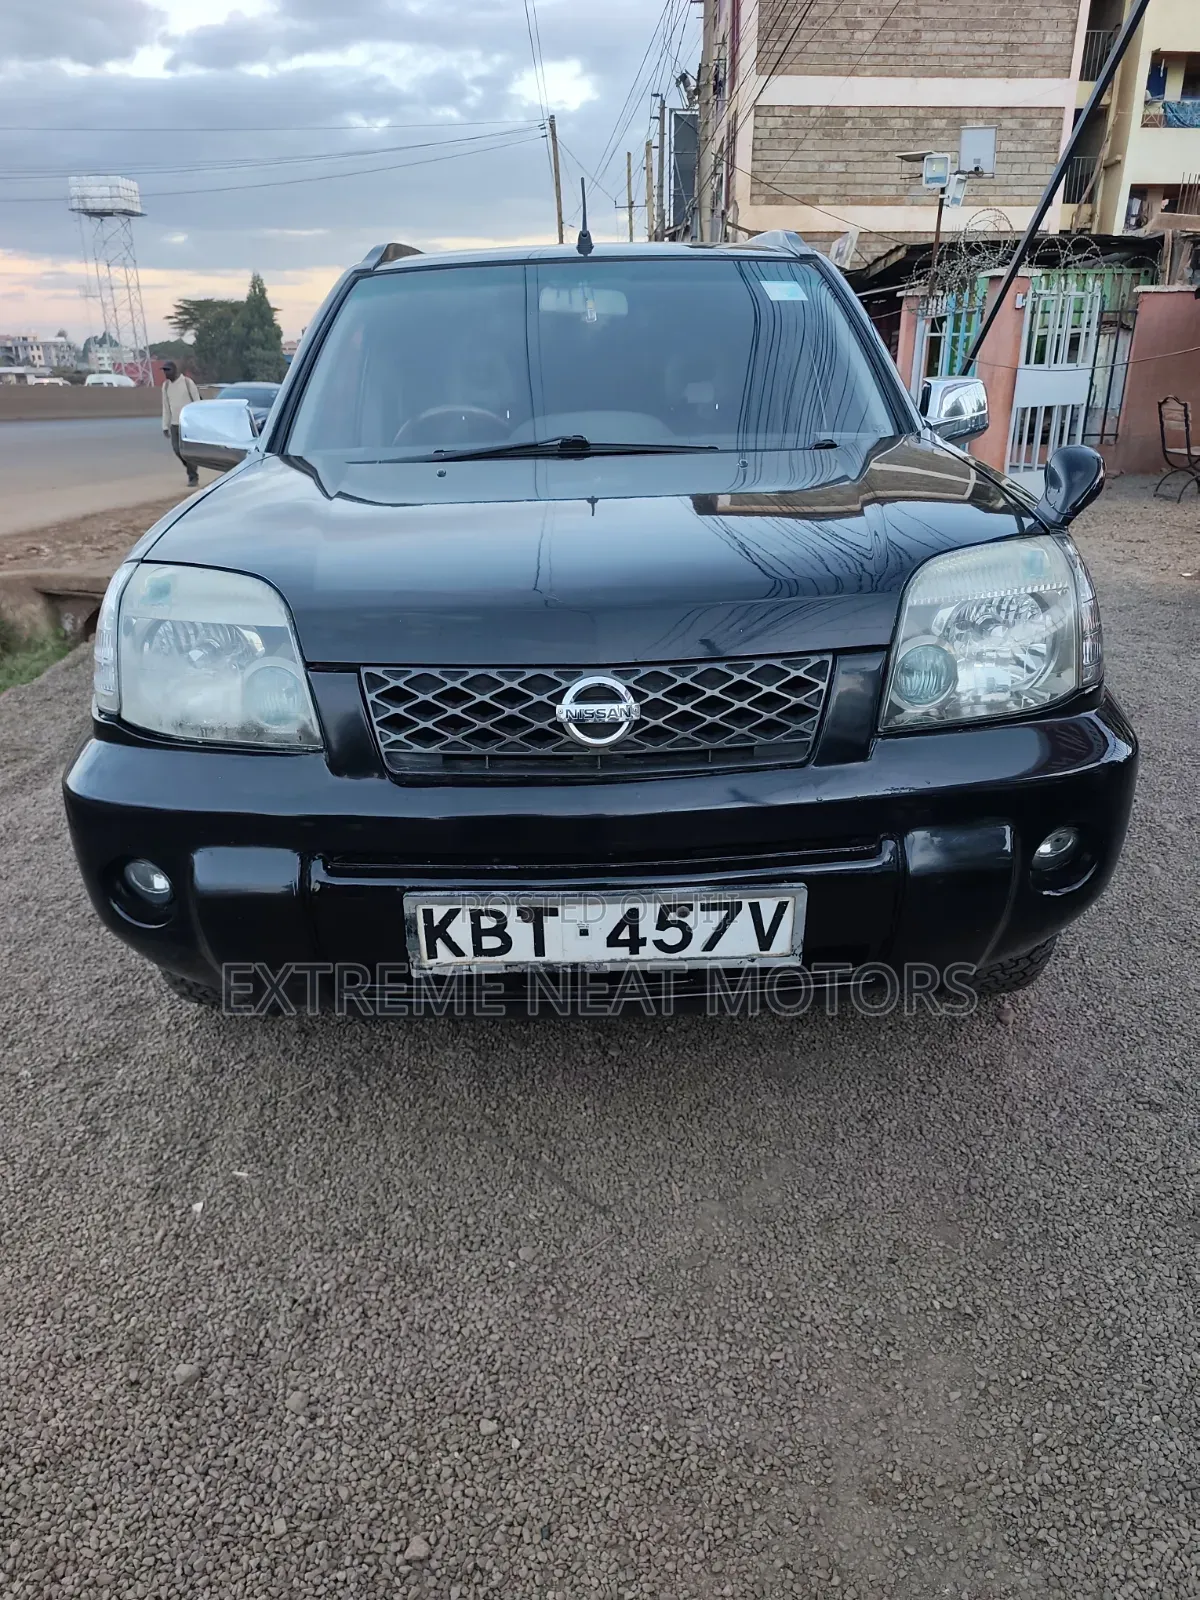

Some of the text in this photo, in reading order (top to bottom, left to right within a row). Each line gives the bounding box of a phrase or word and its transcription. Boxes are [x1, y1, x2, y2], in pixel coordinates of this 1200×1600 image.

[565, 708, 632, 719] NISSAN
[421, 900, 789, 960] KBT 457V
